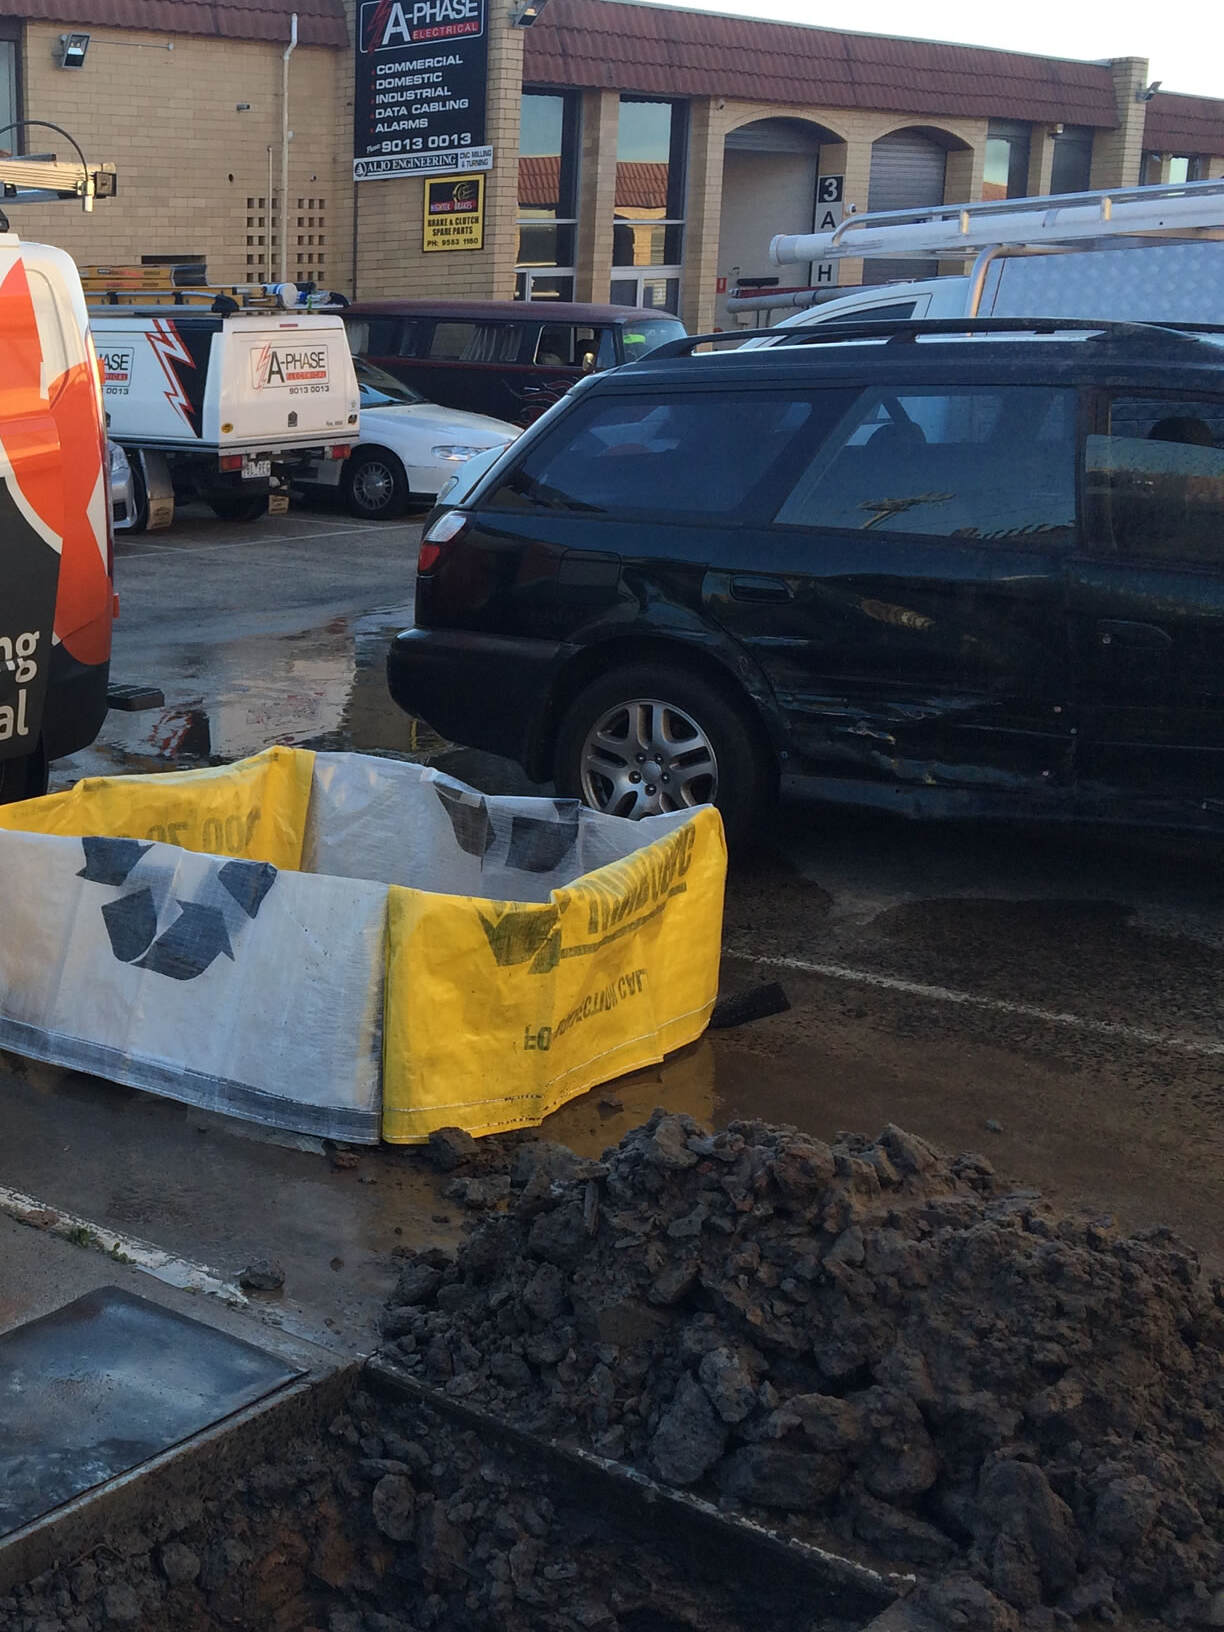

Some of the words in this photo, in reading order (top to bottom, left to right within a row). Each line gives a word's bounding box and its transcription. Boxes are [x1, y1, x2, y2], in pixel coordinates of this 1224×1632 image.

[382, 0, 479, 45] A-PHASE
[412, 22, 479, 40] ELECTRICAL
[376, 55, 463, 75] COMMERCIAL
[376, 72, 443, 90] DOMESTIC
[376, 86, 451, 104] INDUSTRIAL
[376, 107, 408, 119] DATA
[412, 99, 469, 114] CABLING
[376, 118, 428, 133] ALARMS
[381, 137, 423, 153] 9013
[428, 132, 471, 148] 0013
[367, 160, 391, 172] ALJO
[392, 154, 457, 170] ENGINEERING
[823, 178, 838, 201] 3
[427, 217, 449, 227] BRAKE
[455, 216, 479, 226] CLUTCH
[820, 211, 836, 229] A
[432, 227, 451, 237] SPARE
[452, 226, 473, 235] PARTS
[817, 264, 832, 282] H
[267, 350, 326, 384] A-PHASE
[289, 386, 309, 395] 9013
[310, 385, 330, 393] 0013
